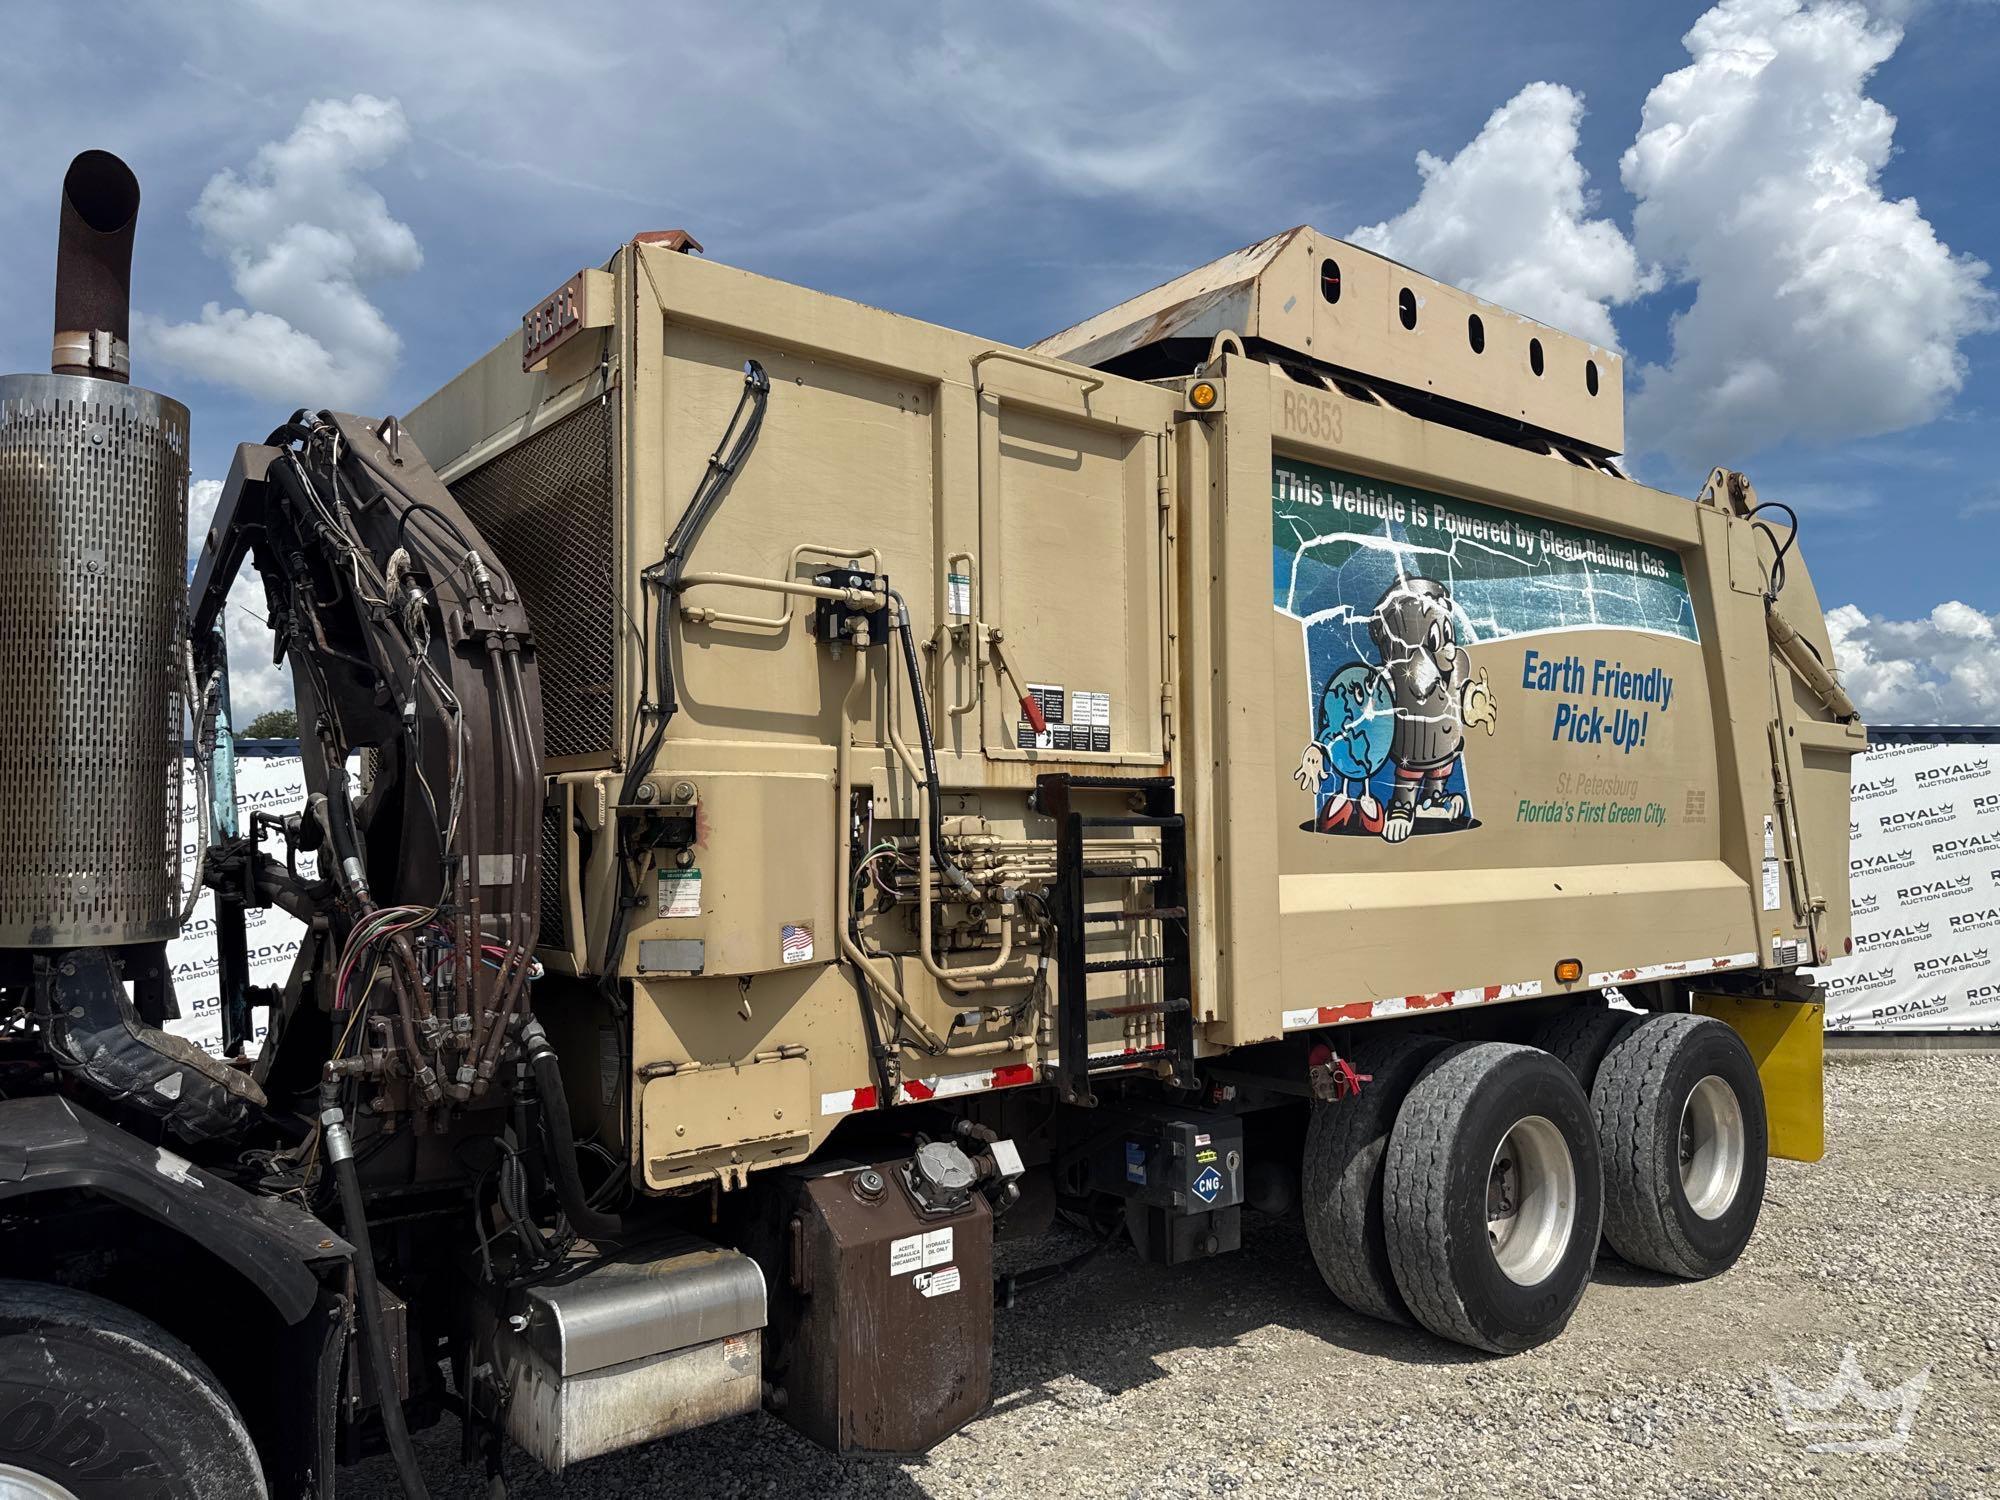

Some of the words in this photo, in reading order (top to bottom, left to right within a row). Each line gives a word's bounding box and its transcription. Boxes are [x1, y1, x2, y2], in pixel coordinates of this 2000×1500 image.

[523, 287, 579, 356] HEIL
[1283, 389, 1344, 444] R6353
[1275, 469, 1324, 506] This
[1329, 481, 1406, 523] Vehicle
[1411, 498, 1428, 527] is
[1433, 503, 1512, 546] Powered
[1515, 521, 1535, 556] by
[1540, 528, 1583, 561] Clean
[1585, 538, 1638, 572] Natural
[1641, 552, 1670, 579] Gas.
[1522, 650, 1586, 695] Earth
[1591, 659, 1674, 712] Friendly
[1552, 703, 1649, 755] Pick-Up!
[1865, 750, 1906, 762] AUCTION
[1907, 743, 1939, 754] GROUP
[264, 756, 302, 769] AUCTIO
[1914, 762, 1974, 782] ROYAL
[1556, 772, 1573, 795] St.
[1575, 773, 1639, 801] Petersburg
[1850, 781, 1880, 795] YAL
[1918, 776, 1959, 789] AUCTION
[1959, 770, 1991, 781] GROUP
[236, 788, 286, 806] OYAL
[268, 795, 304, 807] GROUP
[1865, 788, 1898, 800] GROUP
[1516, 800, 1575, 824] Florida's
[1577, 801, 1606, 824] First
[1608, 802, 1642, 824] Green
[1644, 802, 1667, 828] City.
[1879, 807, 1939, 827] ROYAL
[1976, 805, 2000, 815] AUCT
[1882, 821, 1924, 834] AUCTION
[1924, 814, 1957, 826] GROUP
[1932, 834, 1992, 854] ROYAL
[1850, 853, 1898, 871] OYAL
[1935, 848, 1976, 862] AUCTION
[1882, 860, 1916, 872] GROUP
[1896, 879, 1956, 899] ROYAL
[1900, 893, 1941, 907] AUCTION
[1941, 886, 1974, 898] GROUP
[245, 920, 267, 929] OUP
[1949, 908, 2000, 927] ROYA
[1854, 926, 1915, 946] ROYAL
[1952, 921, 1993, 934] AUCTION
[247, 941, 299, 959] ROYA
[1858, 940, 1899, 954] AUCTION
[1899, 933, 1932, 945] GROUP
[170, 961, 203, 976] YAL
[1913, 952, 1974, 972] ROYAL
[1916, 966, 1957, 980] AUCTION
[1958, 959, 1991, 971] GROUP
[1818, 971, 1879, 990] ROYAL
[1863, 978, 1897, 990] GROUP
[1966, 984, 2000, 1000] ROY
[1871, 999, 1932, 1019] ROYAL
[1874, 1013, 1916, 1027] AUCTION
[1916, 1006, 1949, 1018] GROUP
[1199, 1176, 1220, 1193] CNG
[925, 1238, 951, 1249] HYDRAULIC
